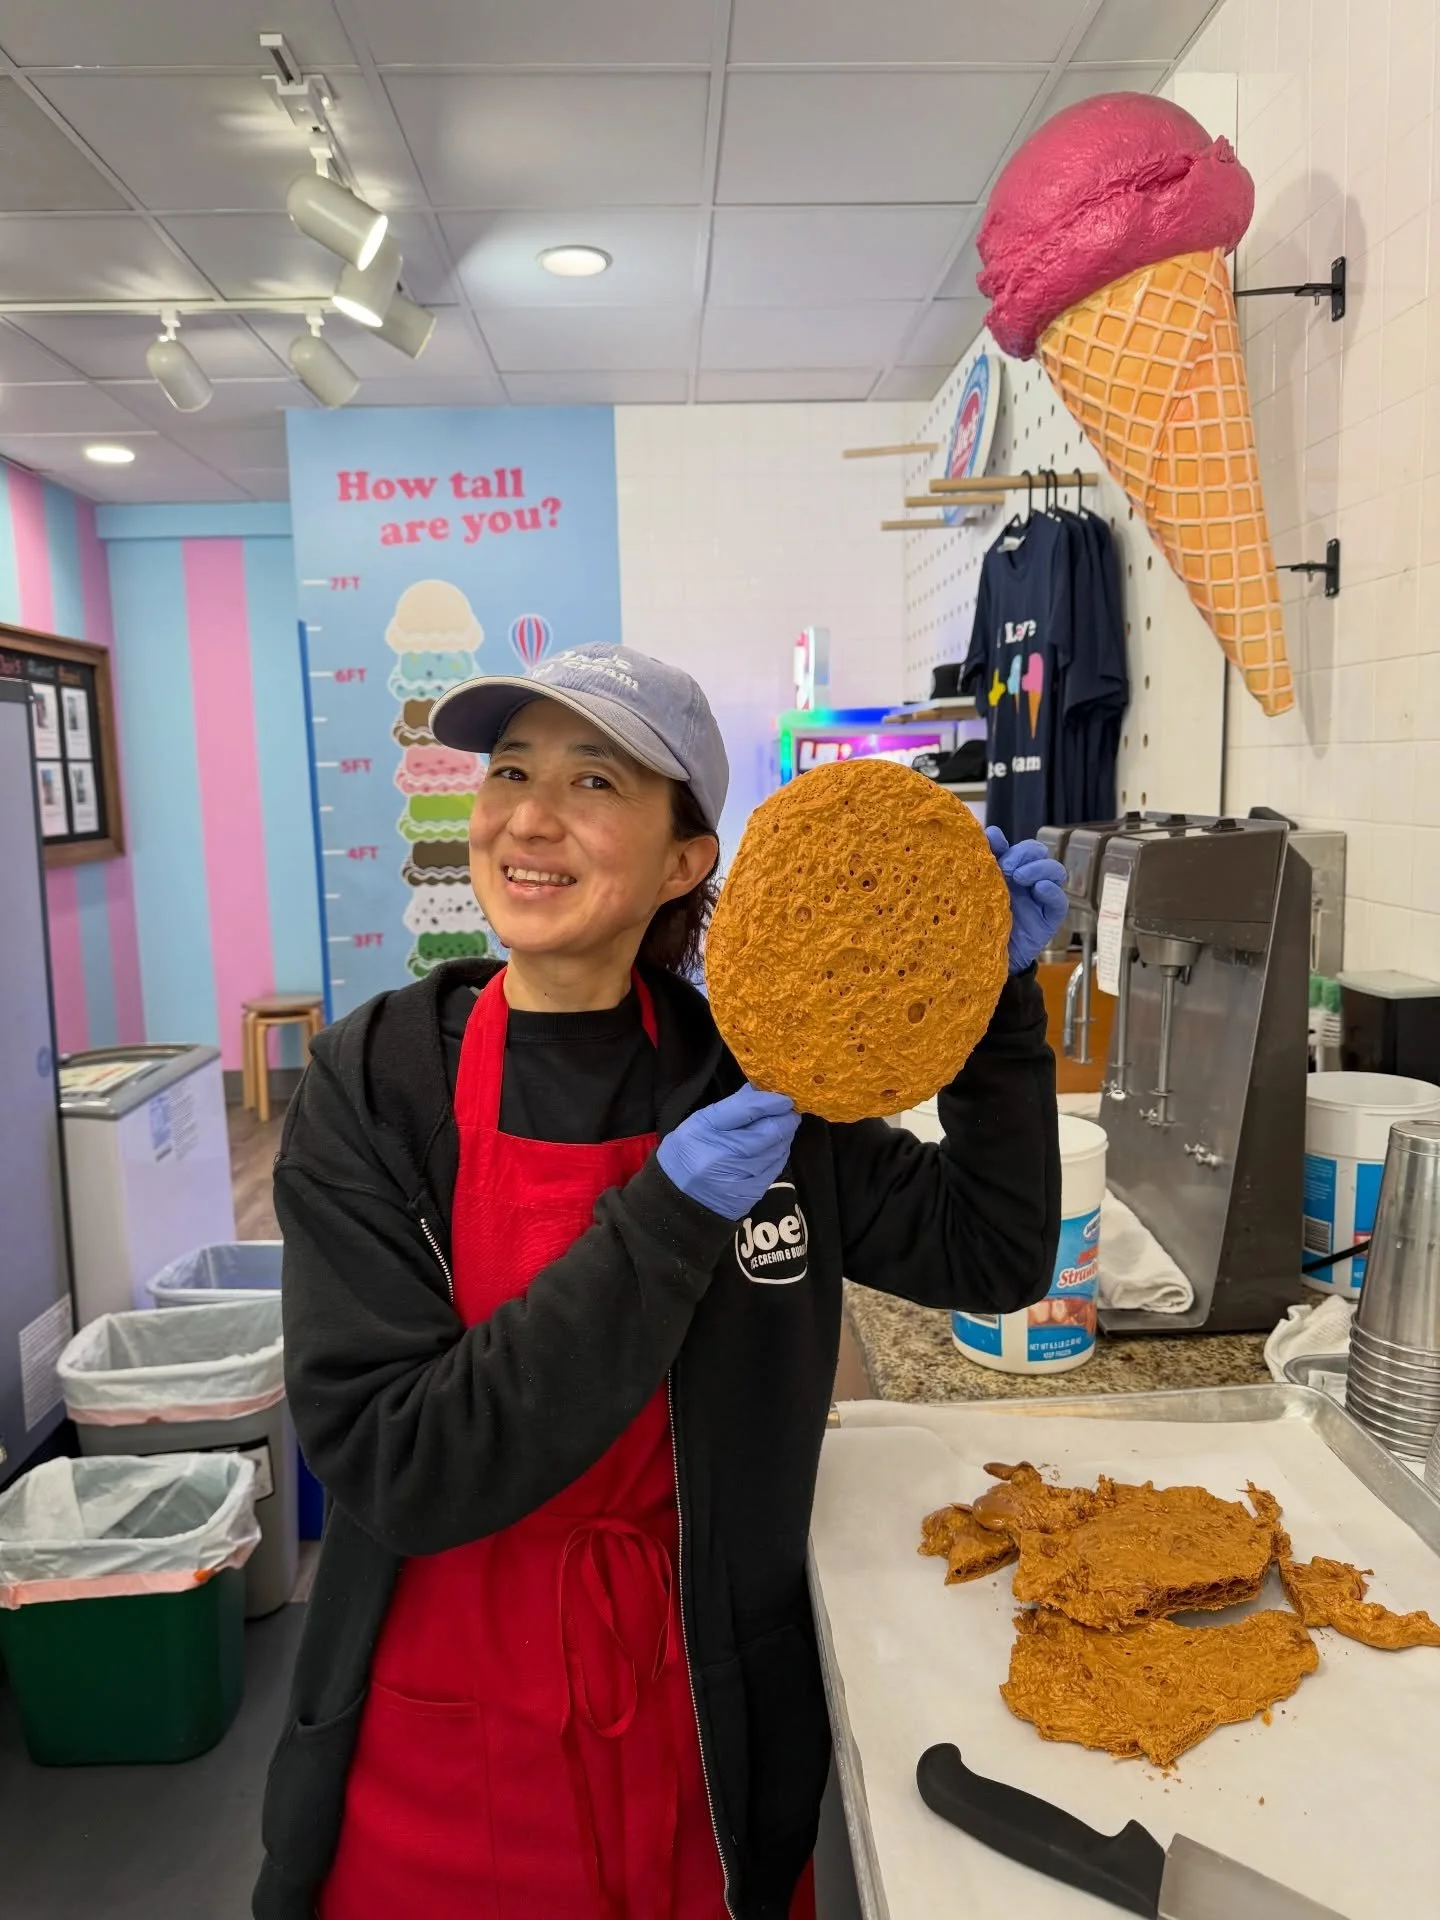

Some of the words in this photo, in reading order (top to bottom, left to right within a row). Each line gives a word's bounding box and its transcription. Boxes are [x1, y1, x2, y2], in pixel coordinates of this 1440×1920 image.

[337, 470, 437, 502] How
[449, 467, 525, 499] tall
[381, 517, 449, 545] are
[461, 497, 562, 544] you?
[330, 576, 359, 591] 7FT
[335, 668, 366, 683] 6FT
[340, 758, 372, 774] 5FT
[347, 845, 379, 860] 4FT
[353, 932, 384, 948] 3FT
[758, 1250, 785, 1266] CREAM
[785, 1248, 792, 1260] &
